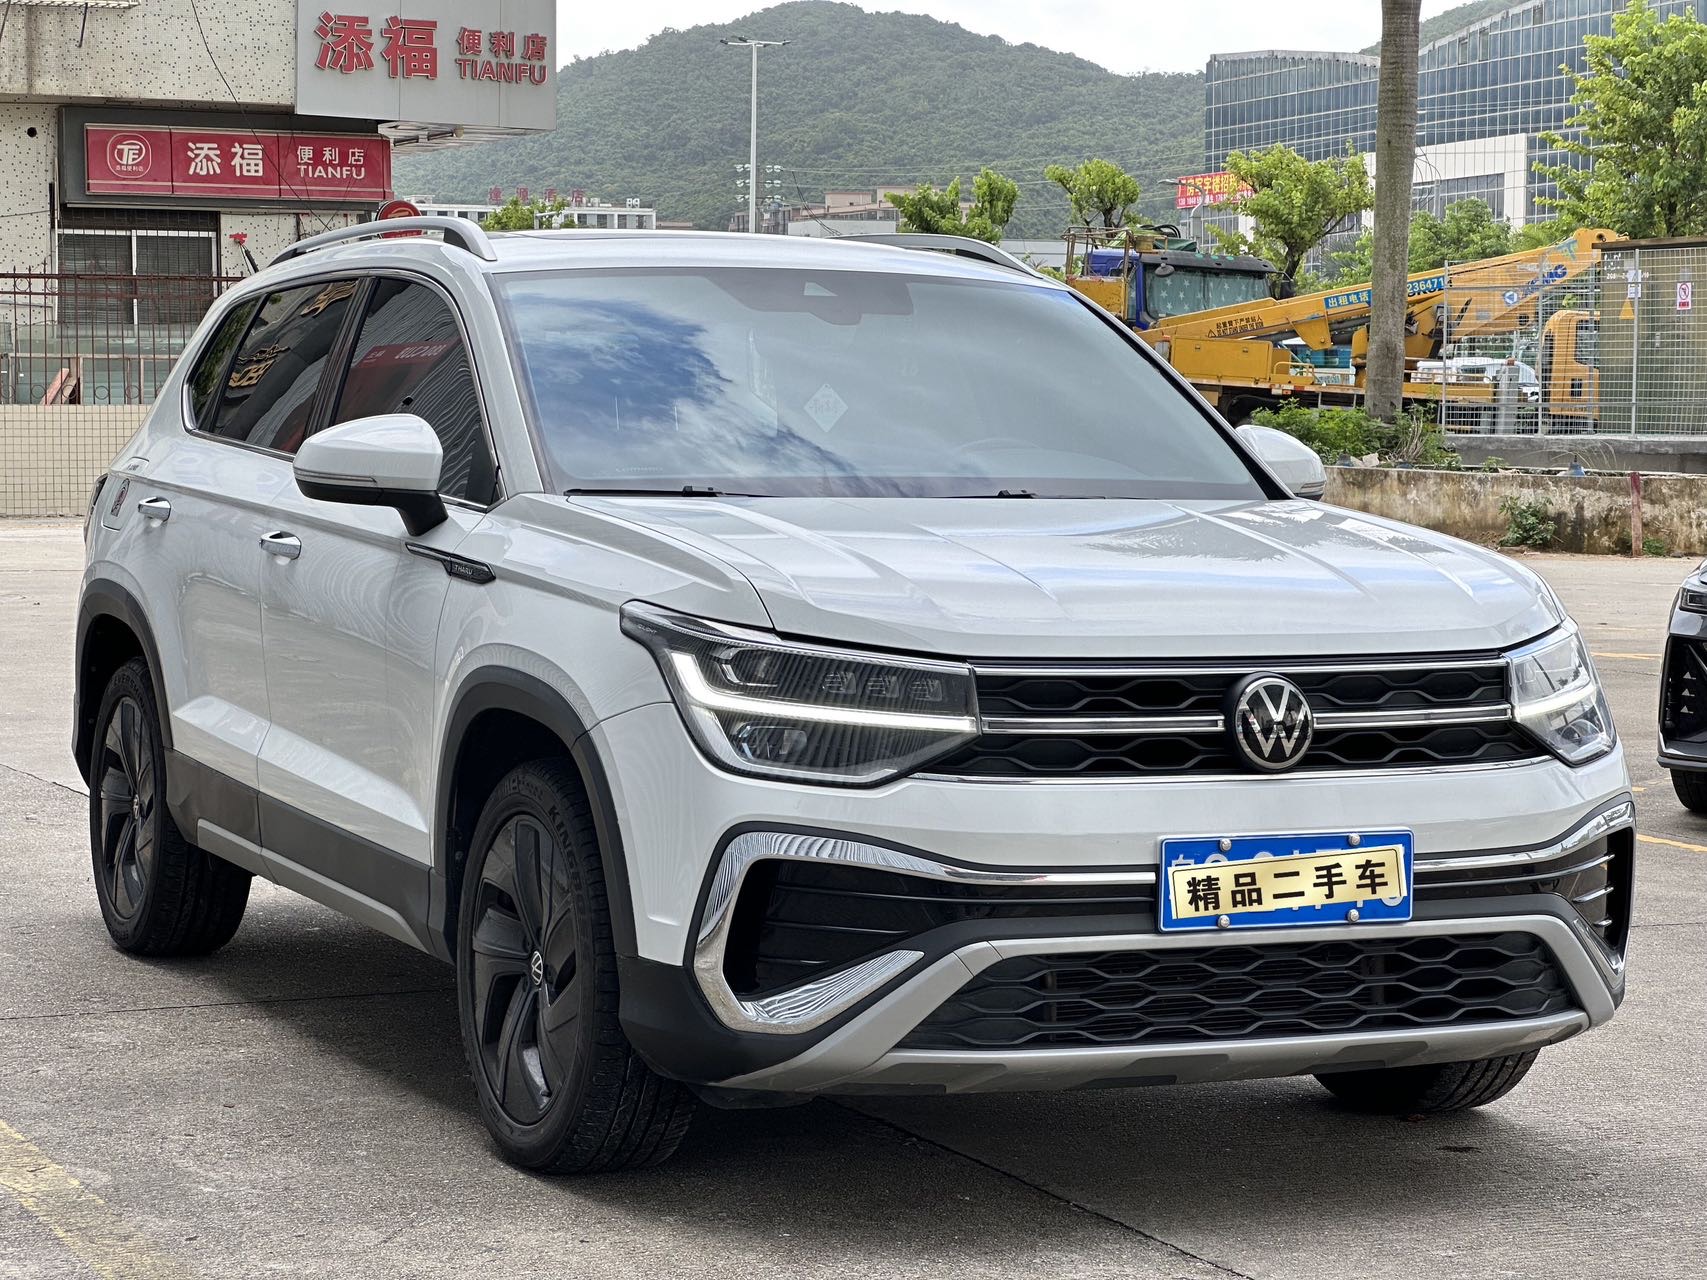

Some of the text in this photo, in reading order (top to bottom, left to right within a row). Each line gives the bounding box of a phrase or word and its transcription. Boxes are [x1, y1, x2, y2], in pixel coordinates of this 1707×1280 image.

[313, 9, 548, 80] 添福 便利店
[456, 58, 548, 85] TIANFU
[187, 142, 364, 177] 添福 便利店
[297, 165, 366, 180] TIANFU
[1328, 291, 1369, 308] 出租电话
[1186, 859, 1390, 913] 精品二手车
